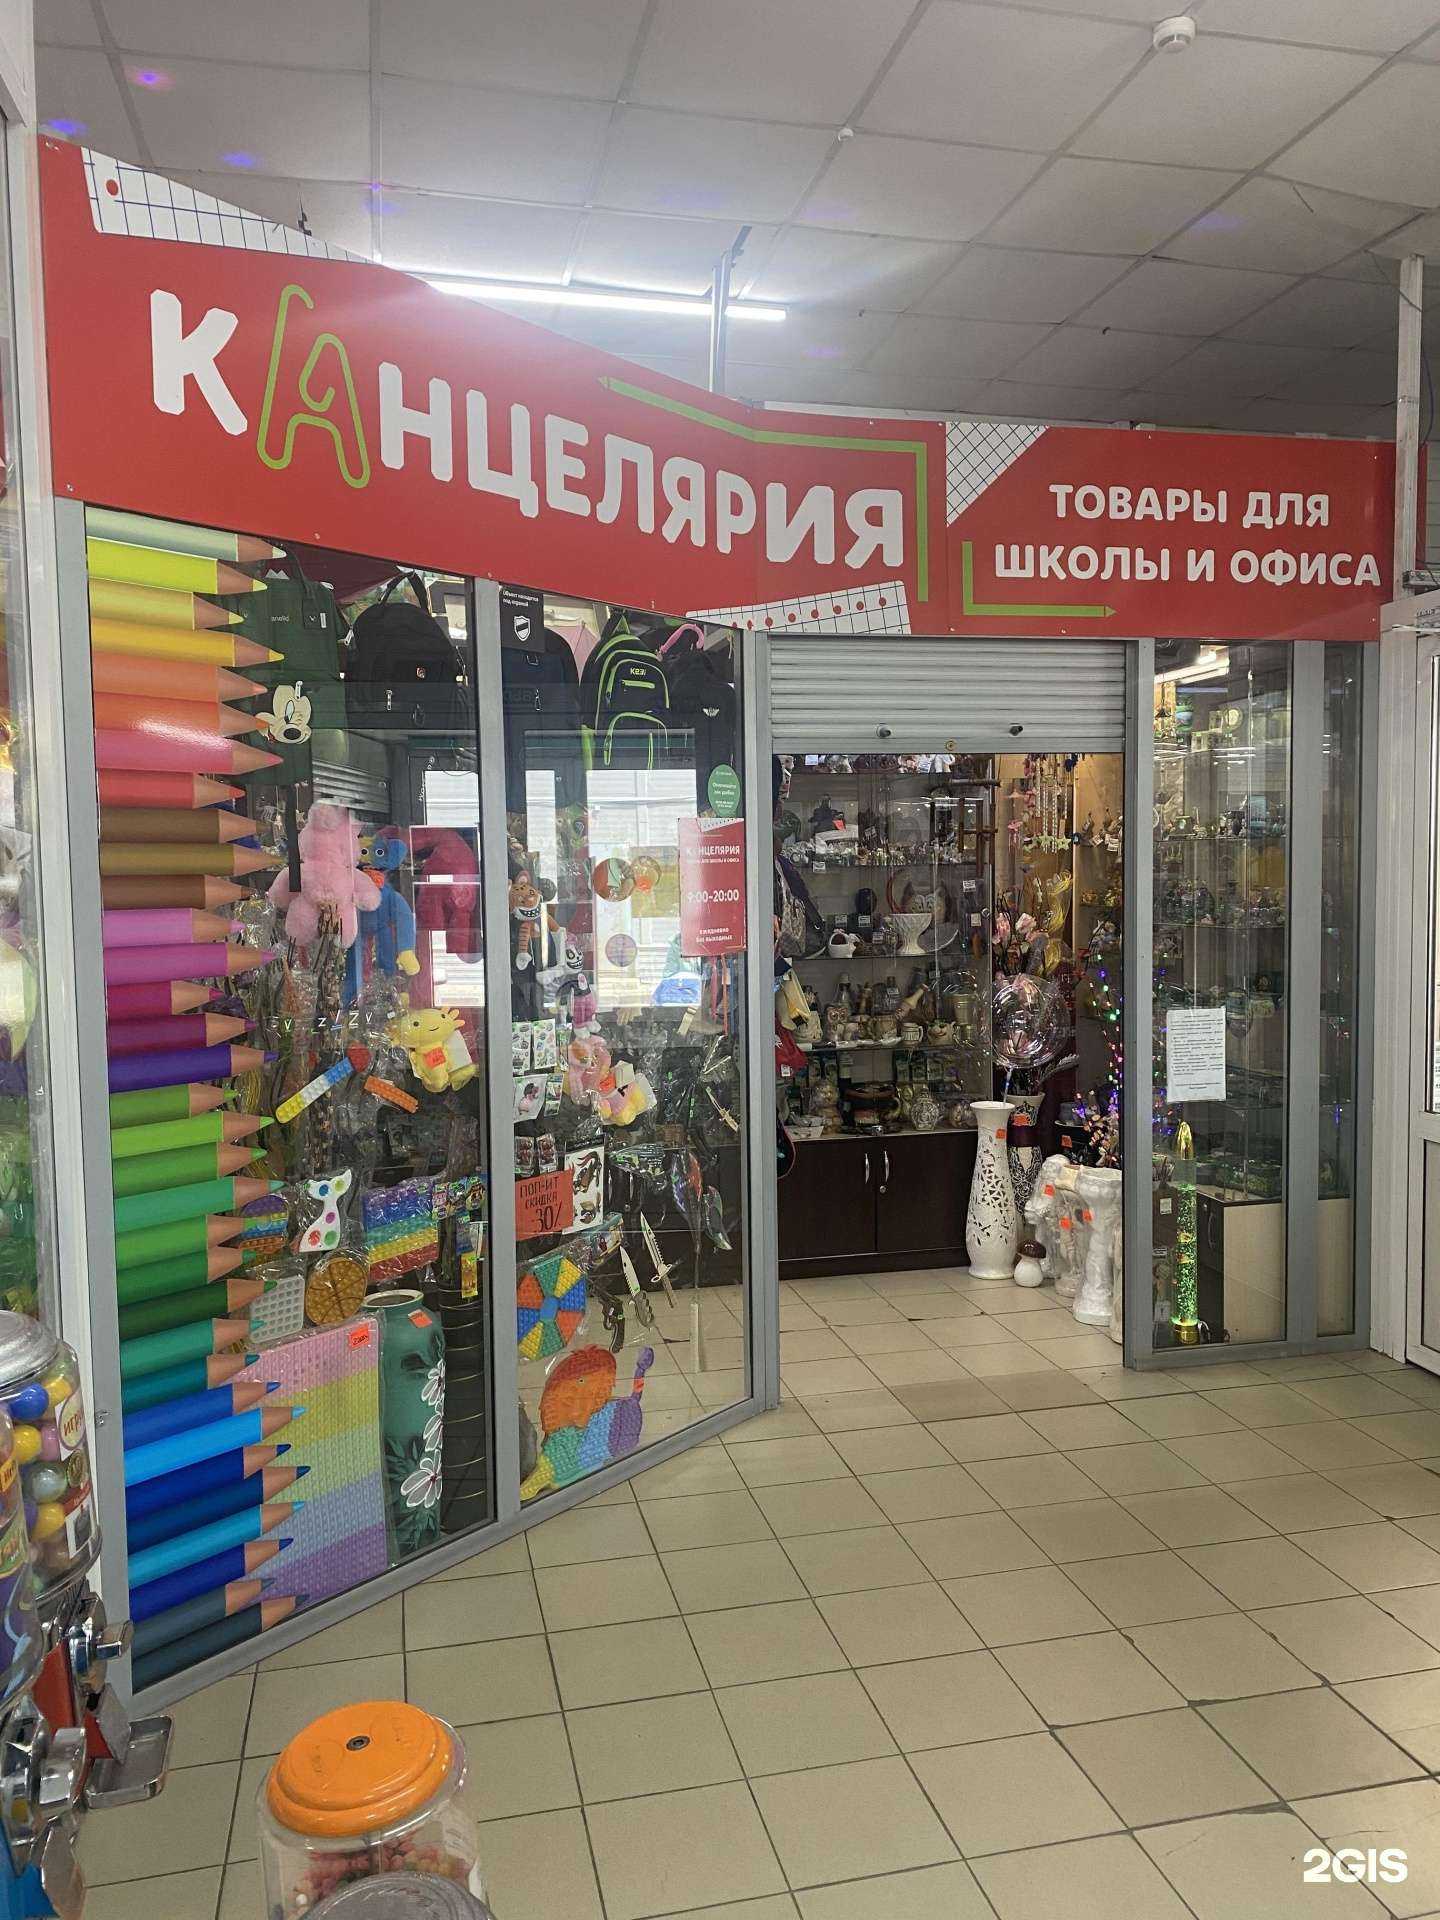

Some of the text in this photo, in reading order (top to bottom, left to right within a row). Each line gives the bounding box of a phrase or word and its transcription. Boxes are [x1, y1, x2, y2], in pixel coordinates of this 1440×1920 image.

[150, 284, 904, 569] КАНЦЕЛЯРИЯ
[1049, 484, 1329, 529] ТОВАРЫ ДЛЯ
[995, 544, 1382, 586] ШКОЛЫ И ОФИСА
[686, 845, 740, 857] КНЦЕЛЯРИЯ
